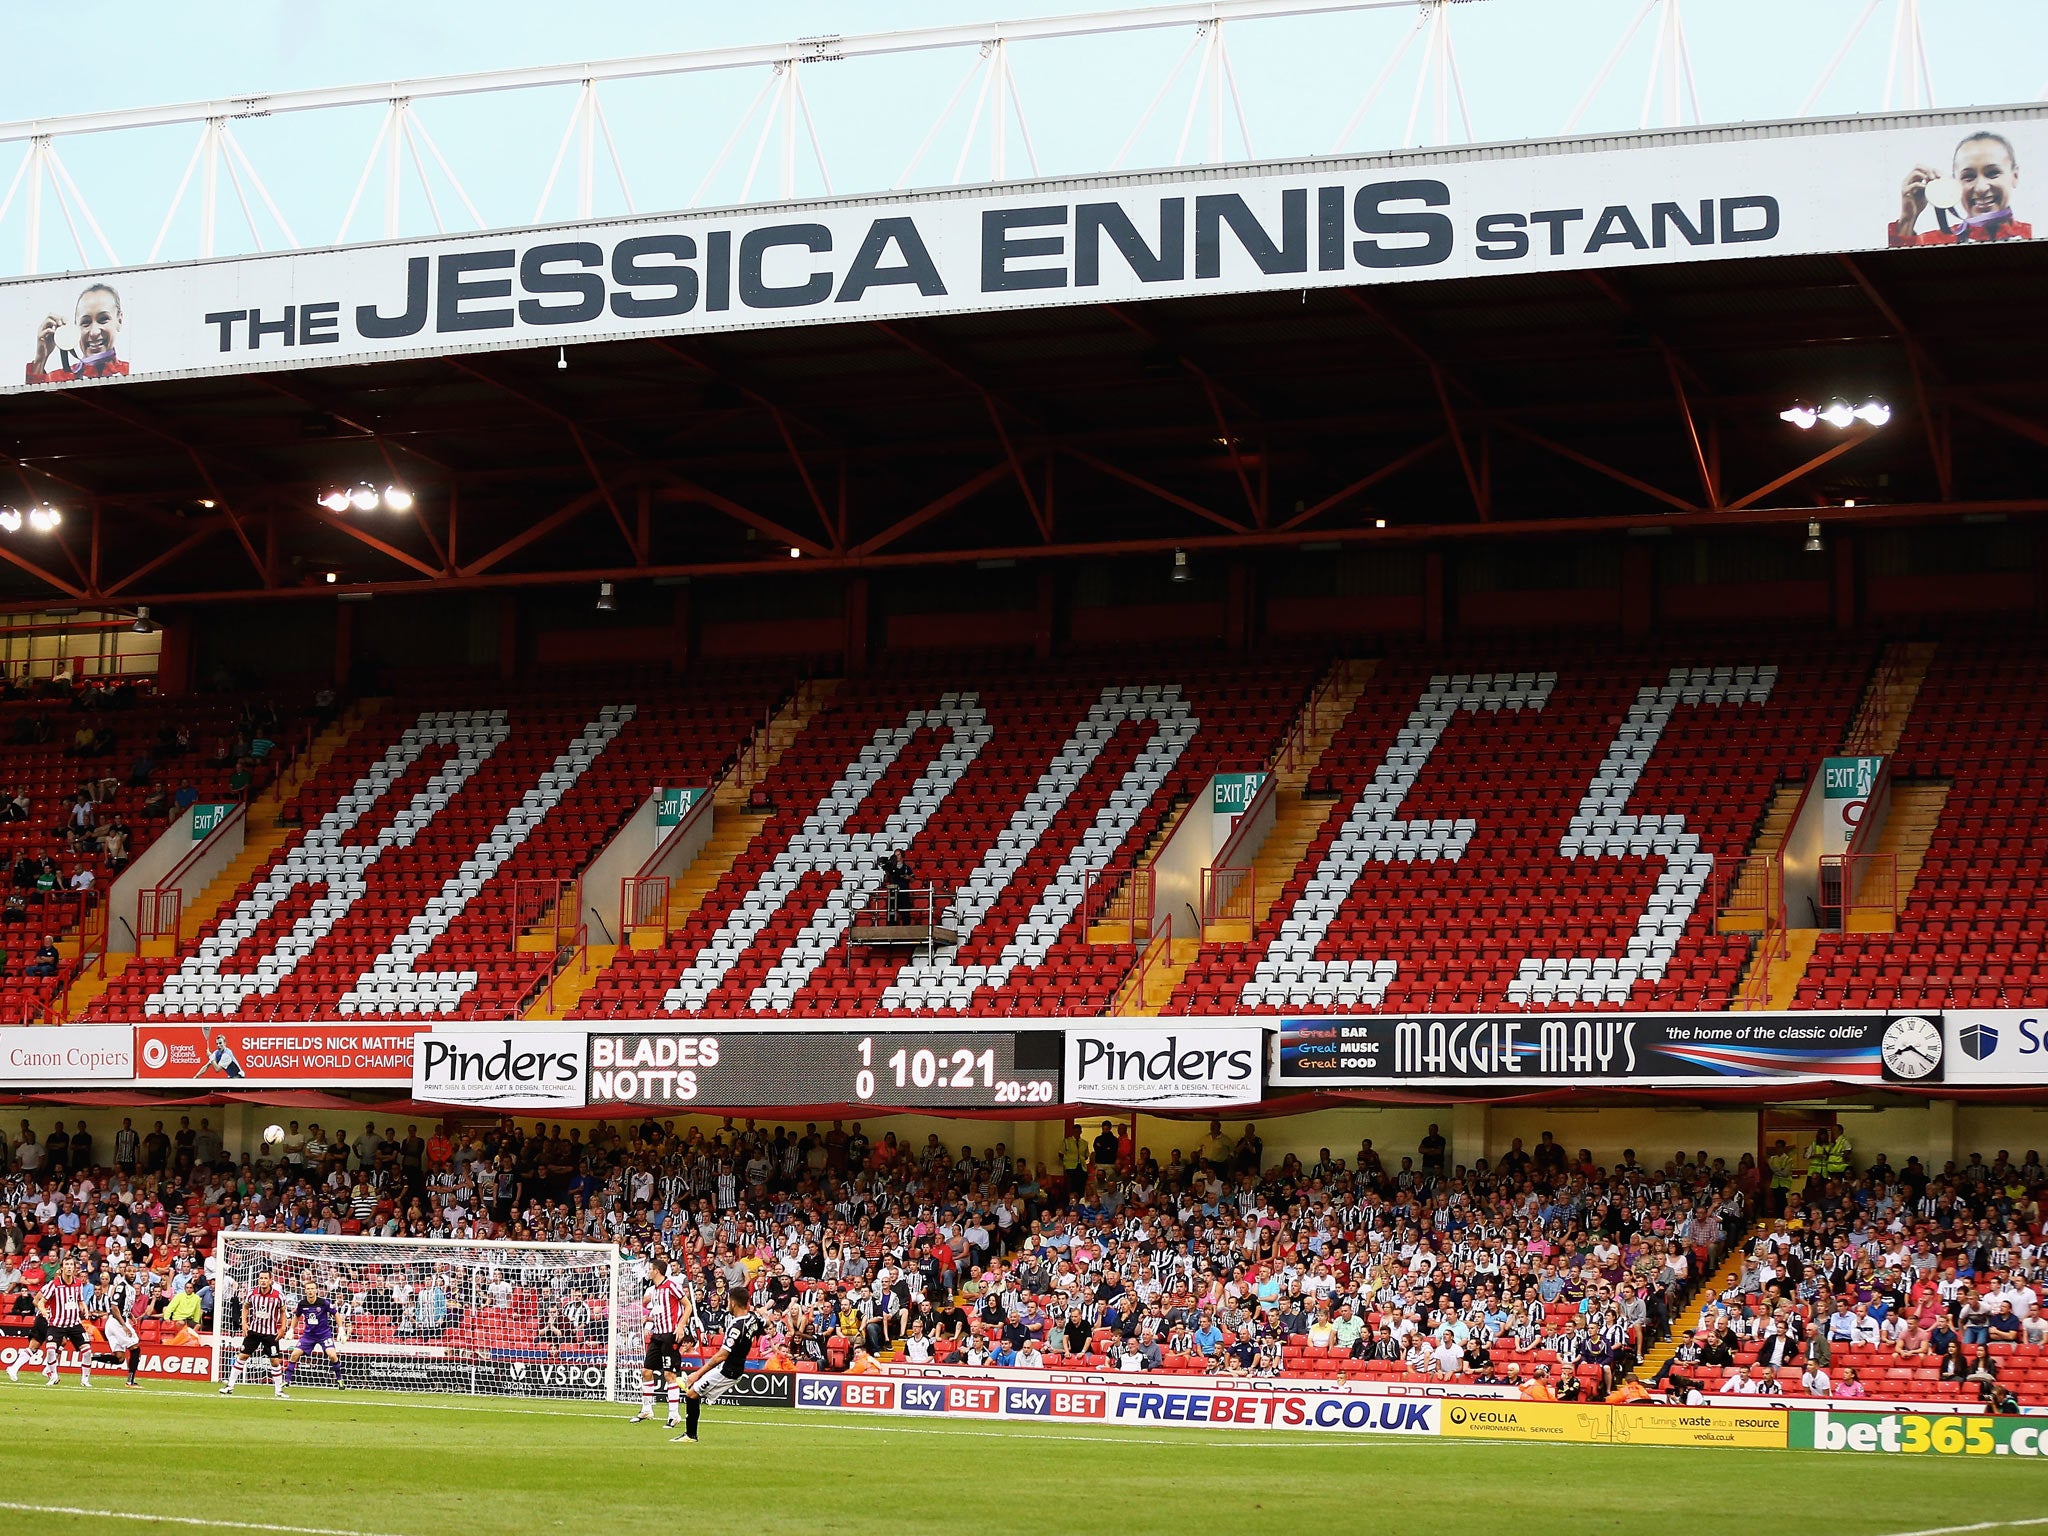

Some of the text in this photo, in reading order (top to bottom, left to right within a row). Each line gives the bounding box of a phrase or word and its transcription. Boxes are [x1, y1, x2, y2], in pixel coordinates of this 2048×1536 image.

[205, 179, 1781, 352] THE JESSICA ENNIS STAND
[1826, 768, 1855, 788] EXIT
[1215, 784, 1242, 803] EXIT
[658, 800, 677, 815] EXIT
[194, 815, 211, 829] EXIT
[1298, 1027, 1368, 1038] Great BAR
[1694, 1026, 1732, 1039] home
[1735, 1026, 1750, 1039] of
[1753, 1026, 1775, 1039] the
[1779, 1026, 1825, 1039] classic
[2019, 1018, 2048, 1054] S
[171, 1044, 194, 1052] England
[242, 1036, 322, 1050] SHEFFIELD'S
[327, 1036, 358, 1050] NICK
[593, 1037, 872, 1067] BLADES 1
[1298, 1042, 1379, 1053] Great MUSIC
[1395, 1021, 1521, 1073] MAGGIE
[10, 1048, 129, 1070] Canon Copiers
[246, 1054, 298, 1068] SQUASH
[303, 1054, 351, 1068] WORLD
[423, 1040, 578, 1081] Pinders
[888, 1049, 994, 1087] 10:21
[1076, 1036, 1252, 1081] Pinders
[1298, 1057, 1377, 1068] Great FOOD
[592, 1071, 874, 1100] NOTTS 0
[995, 1081, 1052, 1102] 20:20
[802, 1380, 890, 1406] sky BET
[905, 1382, 994, 1410] sky BET
[1010, 1387, 1101, 1414] sky BET
[1116, 1392, 1432, 1431] FREEBETS.CO.UK
[1469, 1412, 1517, 1423] VEOLIA
[1470, 1424, 1564, 1434] ENVIRONMENTAL SERVICES
[1650, 1416, 1677, 1427] Turning
[1679, 1416, 1711, 1426] waste
[1713, 1418, 1727, 1427] into
[1735, 1418, 1779, 1428] resource
[1694, 1433, 1734, 1441] veolia.co.uk
